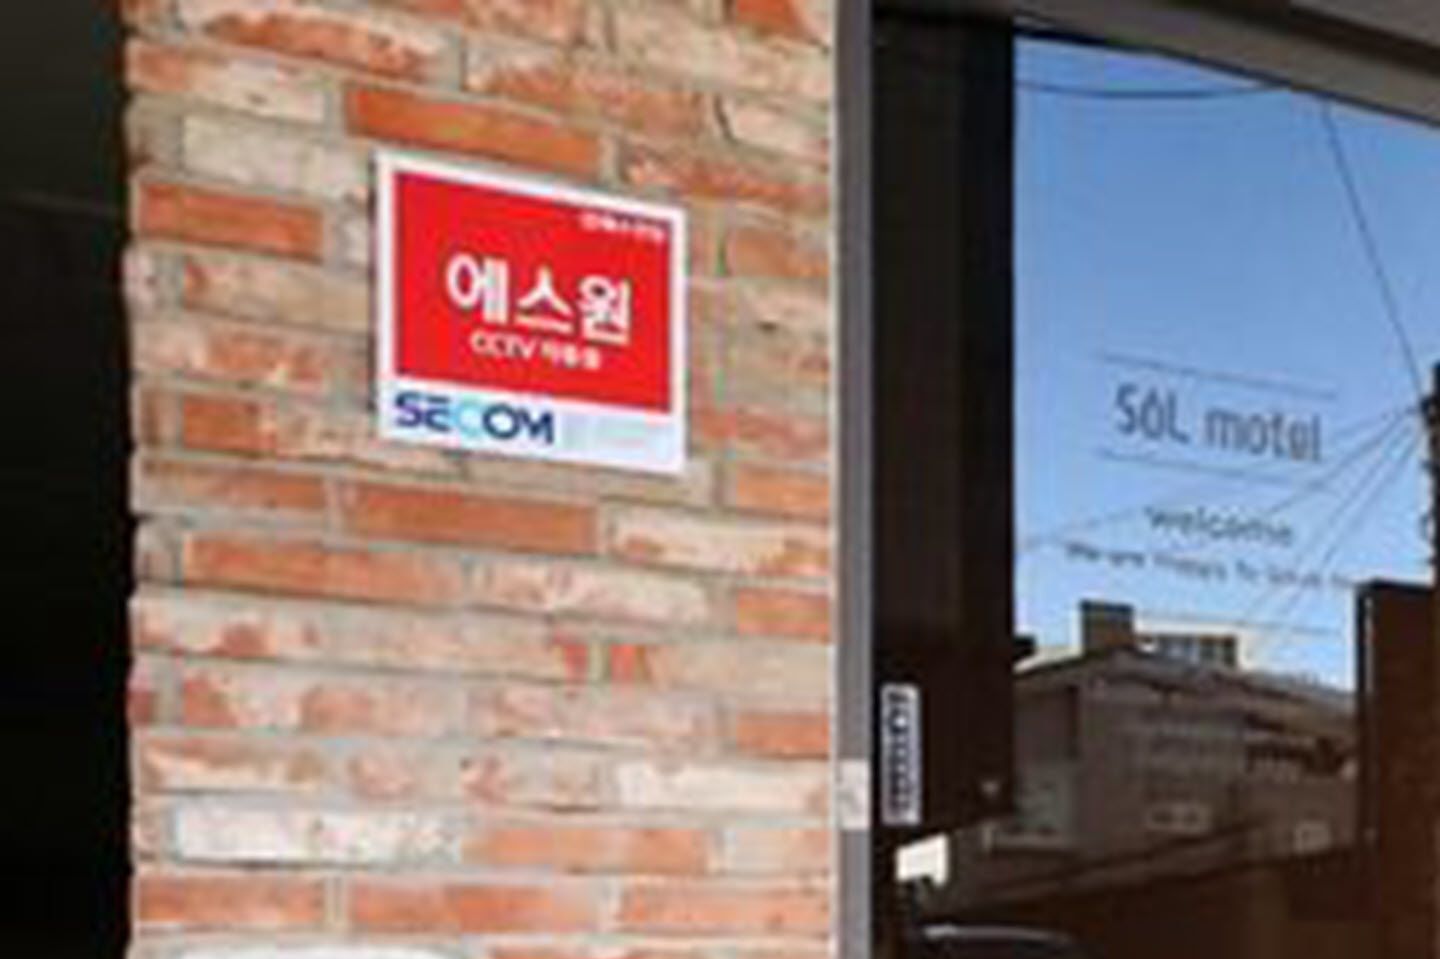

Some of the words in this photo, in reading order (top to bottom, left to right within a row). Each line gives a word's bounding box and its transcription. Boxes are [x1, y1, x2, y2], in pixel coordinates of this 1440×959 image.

[446, 253, 633, 346] 에스원
[470, 328, 538, 360] CCTV
[394, 390, 556, 445] SECOM
[1204, 407, 1324, 462] motel
